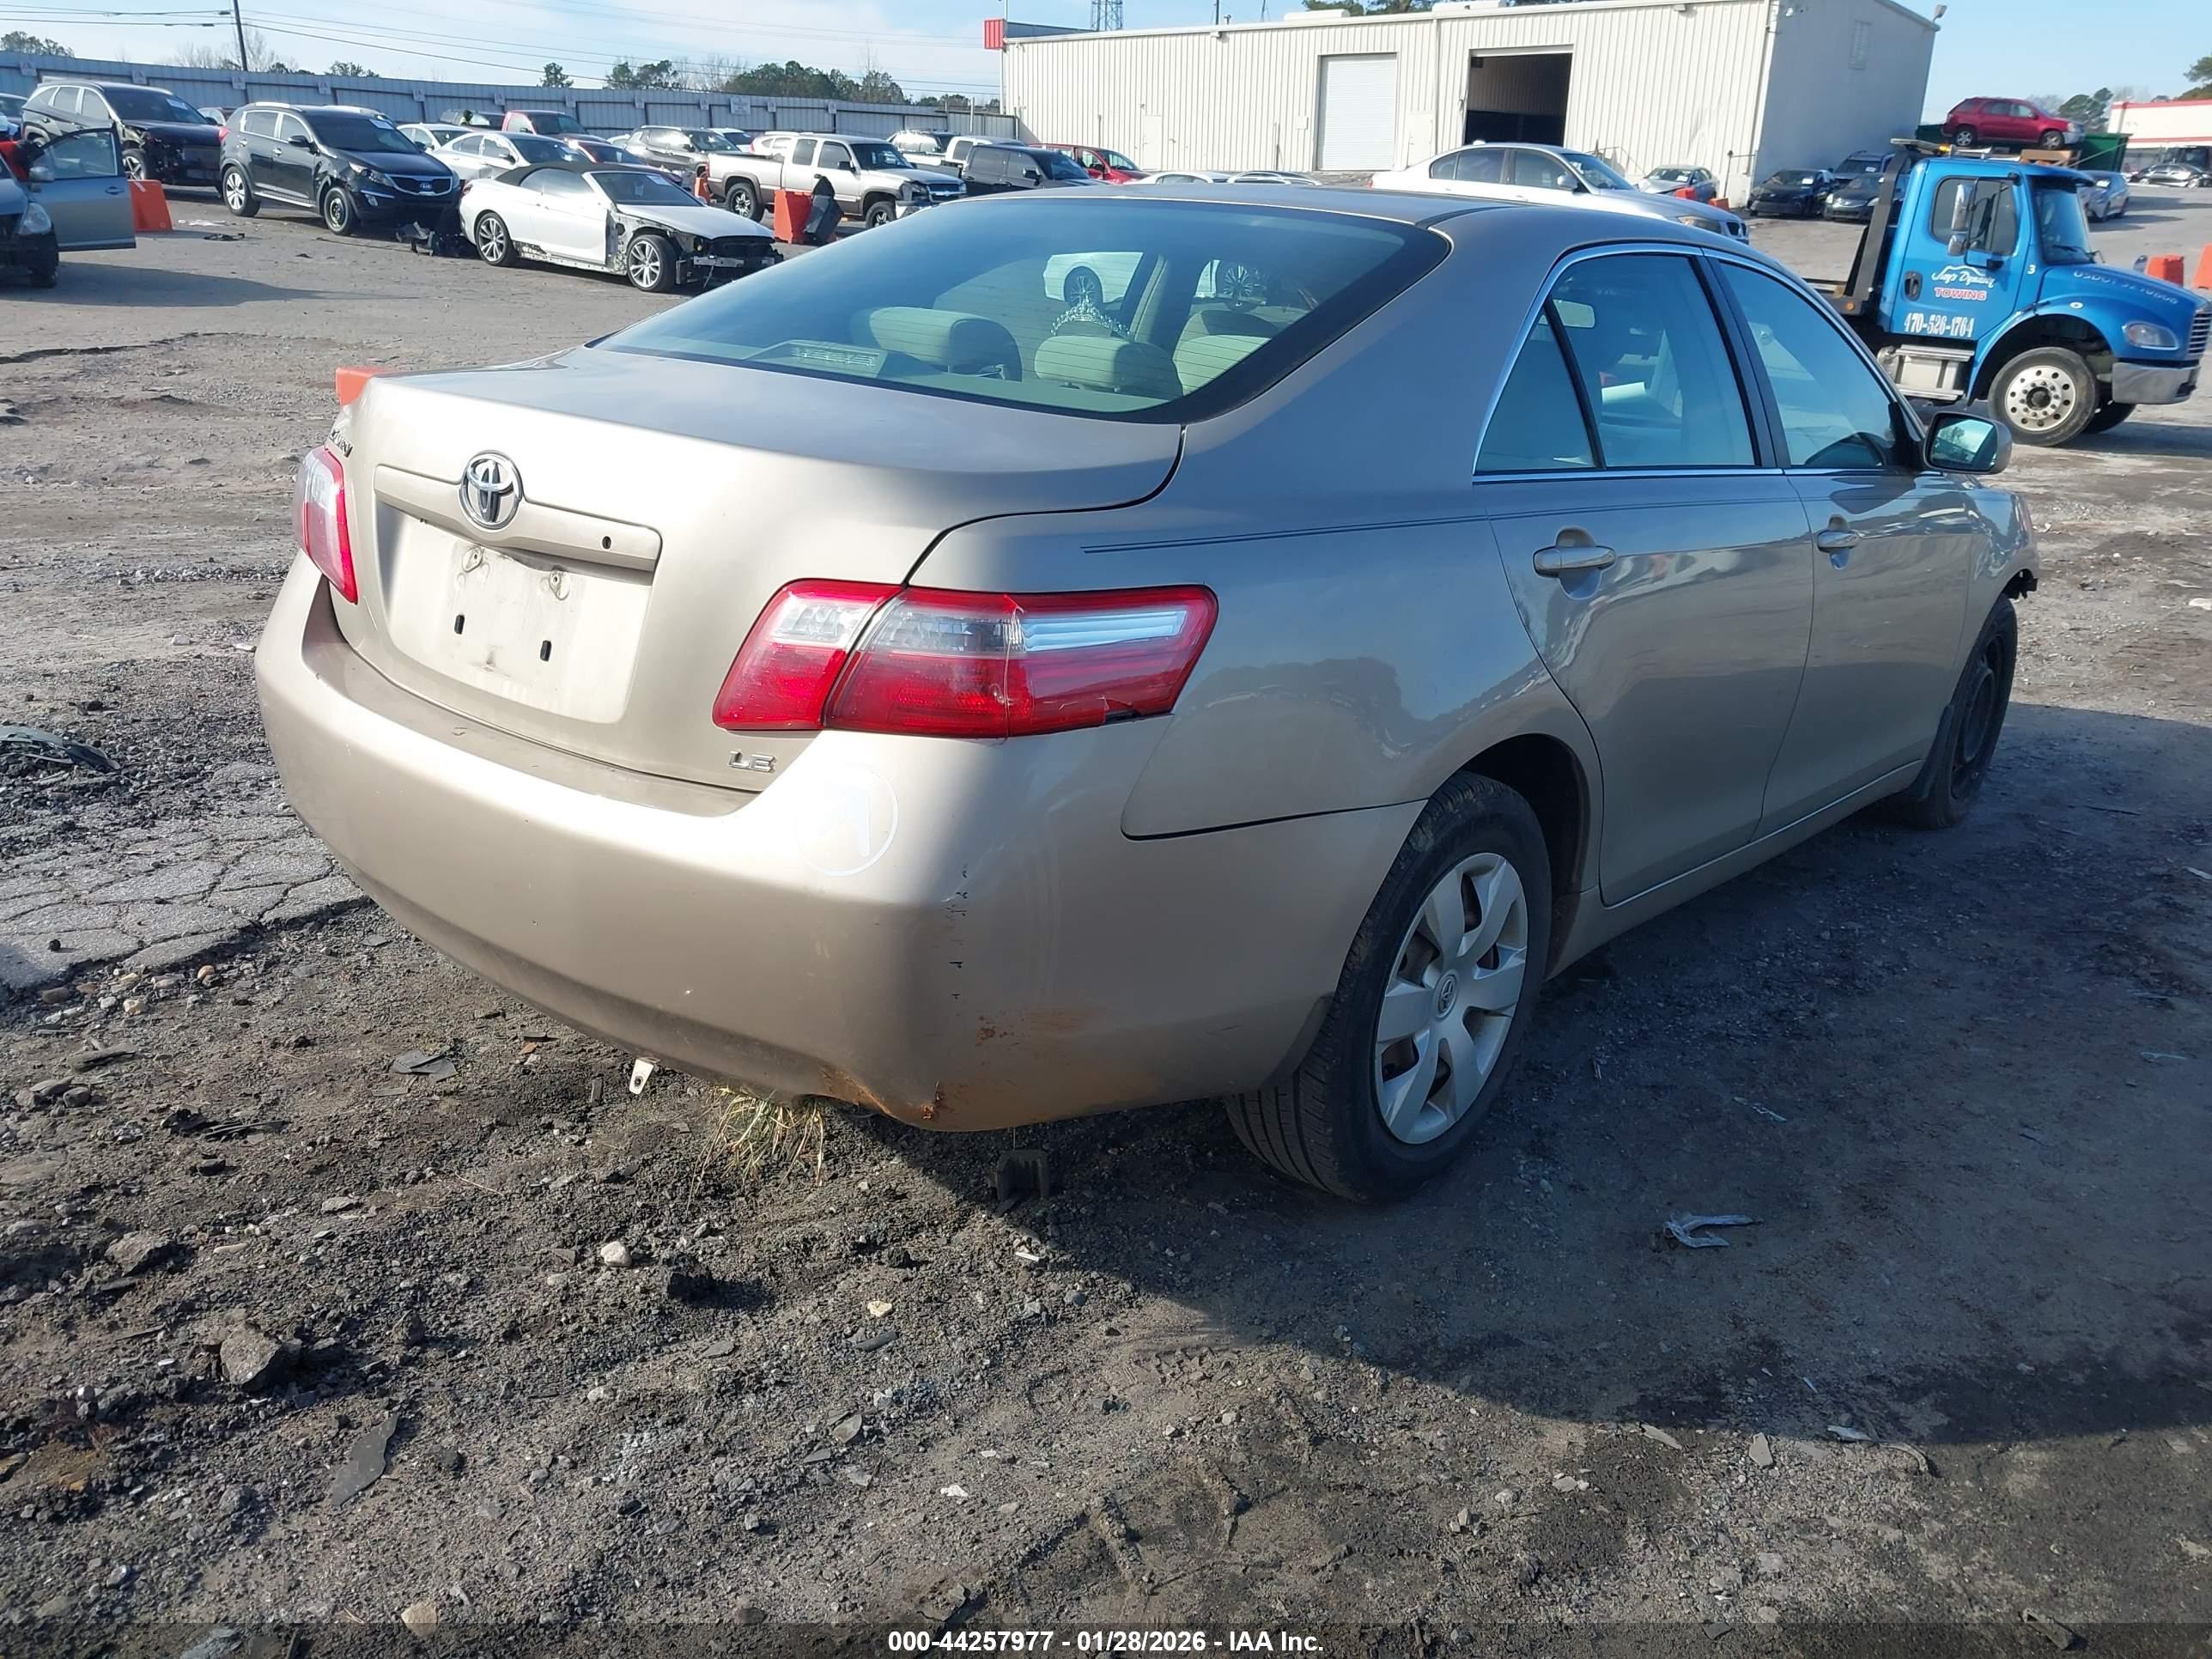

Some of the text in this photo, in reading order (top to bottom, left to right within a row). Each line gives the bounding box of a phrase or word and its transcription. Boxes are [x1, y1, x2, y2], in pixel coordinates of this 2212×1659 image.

[2027, 264, 2036, 275] 3
[1934, 287, 1987, 301] TOWING
[1904, 313, 1974, 337] 470-526-1764
[728, 750, 776, 773] LE
